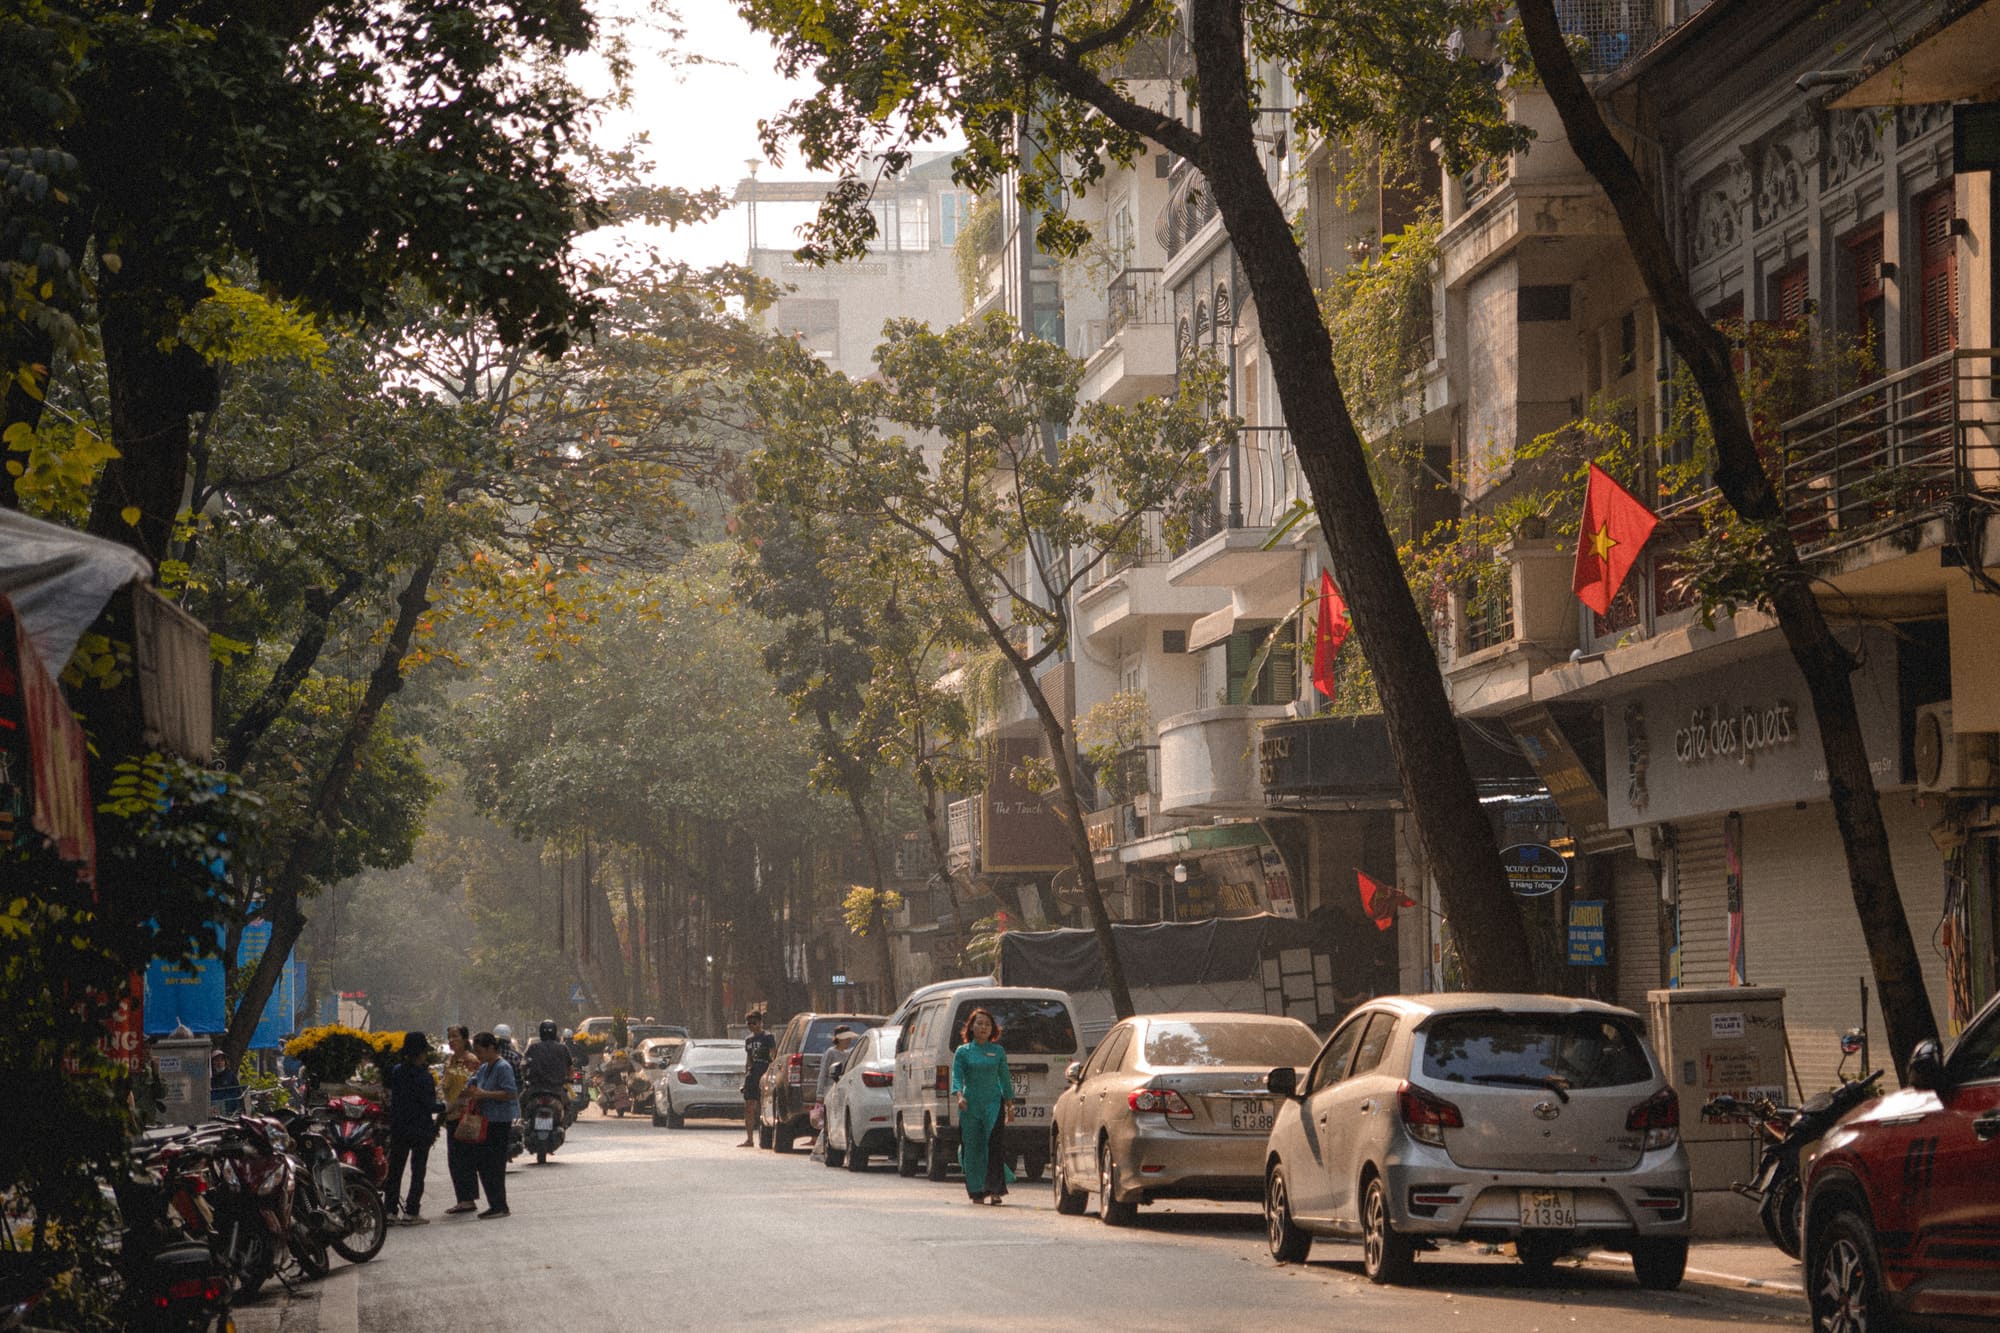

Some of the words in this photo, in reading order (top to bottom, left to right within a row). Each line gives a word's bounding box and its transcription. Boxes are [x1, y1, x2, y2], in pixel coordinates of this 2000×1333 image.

[1675, 708, 1706, 762] café
[1710, 703, 1737, 754] des
[1738, 699, 1793, 766] jouets
[992, 801, 1010, 815] The
[1531, 864, 1565, 873] CENTRAL
[1242, 1100, 1265, 1115] 30A
[1233, 1115, 1273, 1129] 613.88
[1522, 1208, 1574, 1226] 213.94
